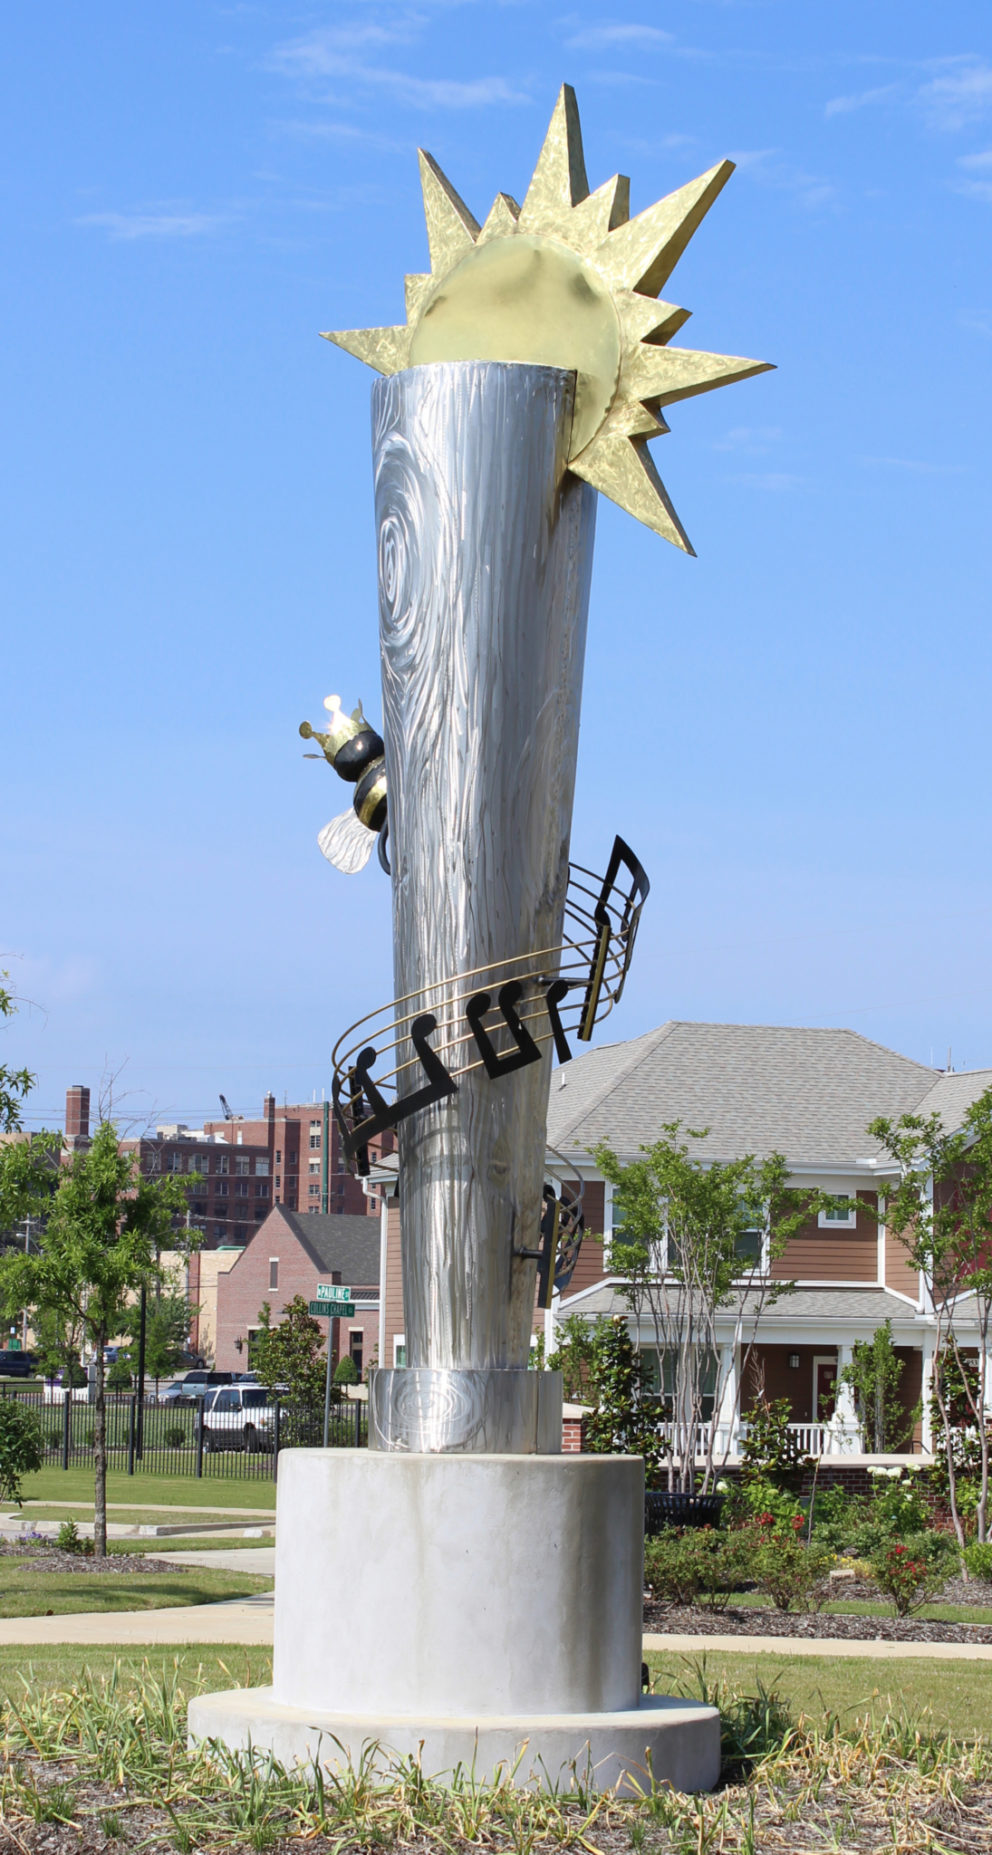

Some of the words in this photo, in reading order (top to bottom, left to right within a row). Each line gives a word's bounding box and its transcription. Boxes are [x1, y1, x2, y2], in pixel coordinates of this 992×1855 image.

[320, 1286, 345, 1299] PAULINE
[310, 1303, 329, 1314] COLLINS
[330, 1304, 348, 1316] CHAPEL
